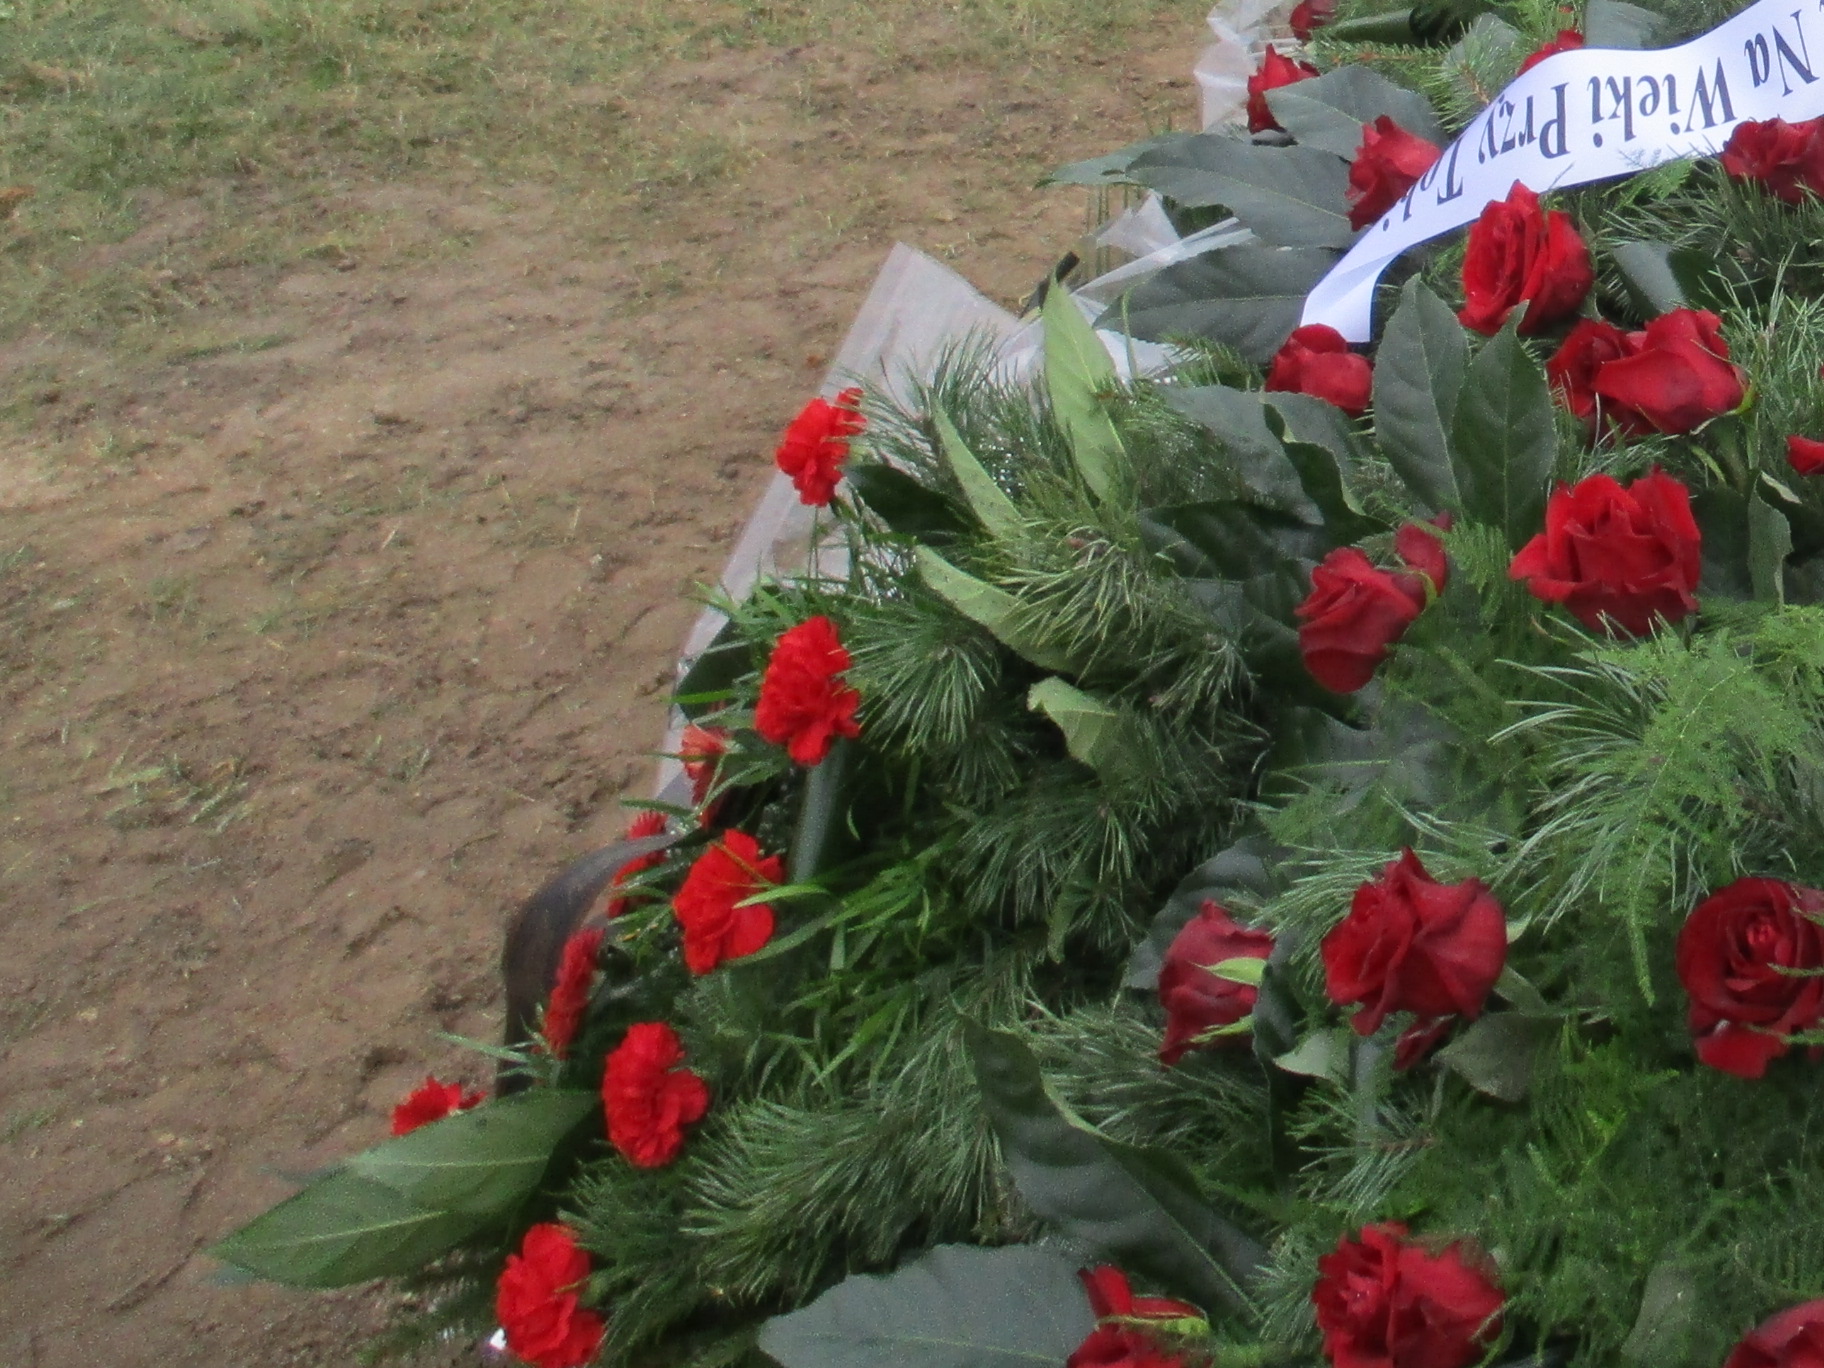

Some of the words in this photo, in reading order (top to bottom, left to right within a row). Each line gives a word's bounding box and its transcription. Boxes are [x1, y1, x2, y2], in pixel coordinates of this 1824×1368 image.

[1744, 9, 1821, 97] Na
[1478, 82, 1571, 165] Przy
[1587, 57, 1739, 148] Wieki
